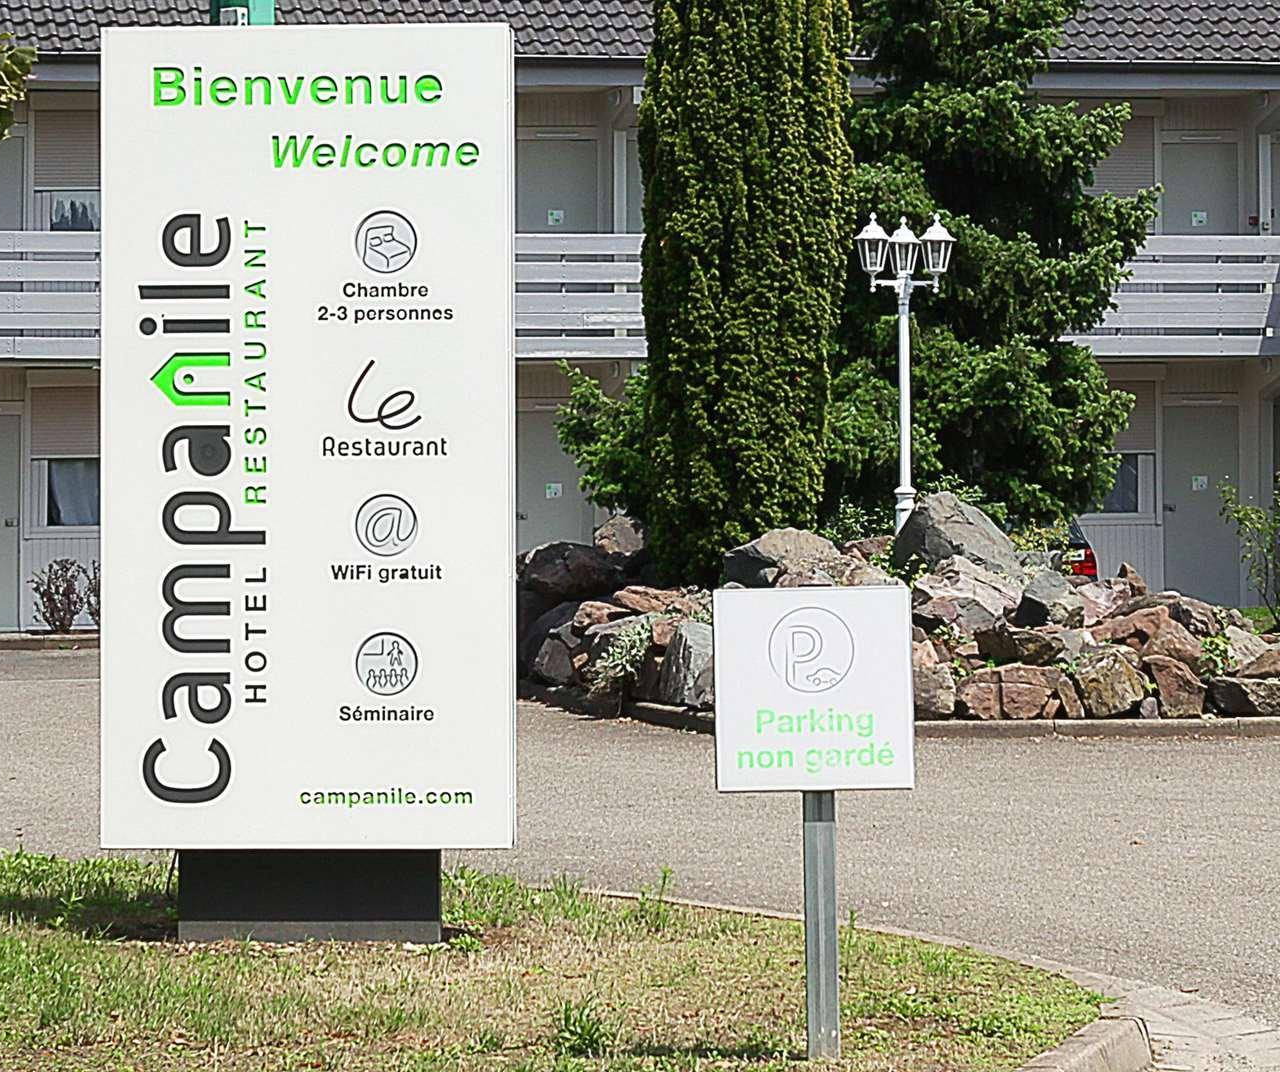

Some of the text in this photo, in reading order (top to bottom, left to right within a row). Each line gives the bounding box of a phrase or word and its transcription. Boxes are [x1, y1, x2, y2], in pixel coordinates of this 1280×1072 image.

[152, 66, 443, 107] Bienvenue
[271, 134, 480, 169] Welcome
[342, 282, 429, 298] Chambre
[317, 305, 454, 326] 2-3 personnes
[322, 435, 448, 457] Restaurant
[243, 219, 268, 704] HOTEL RESTAURANT
[138, 213, 267, 804] Campanile
[330, 564, 443, 584] WiFi gratuit
[339, 705, 435, 722] Séminaire
[755, 708, 874, 738] Parking
[736, 741, 895, 773] non gardé
[299, 787, 473, 809] campanile.com
